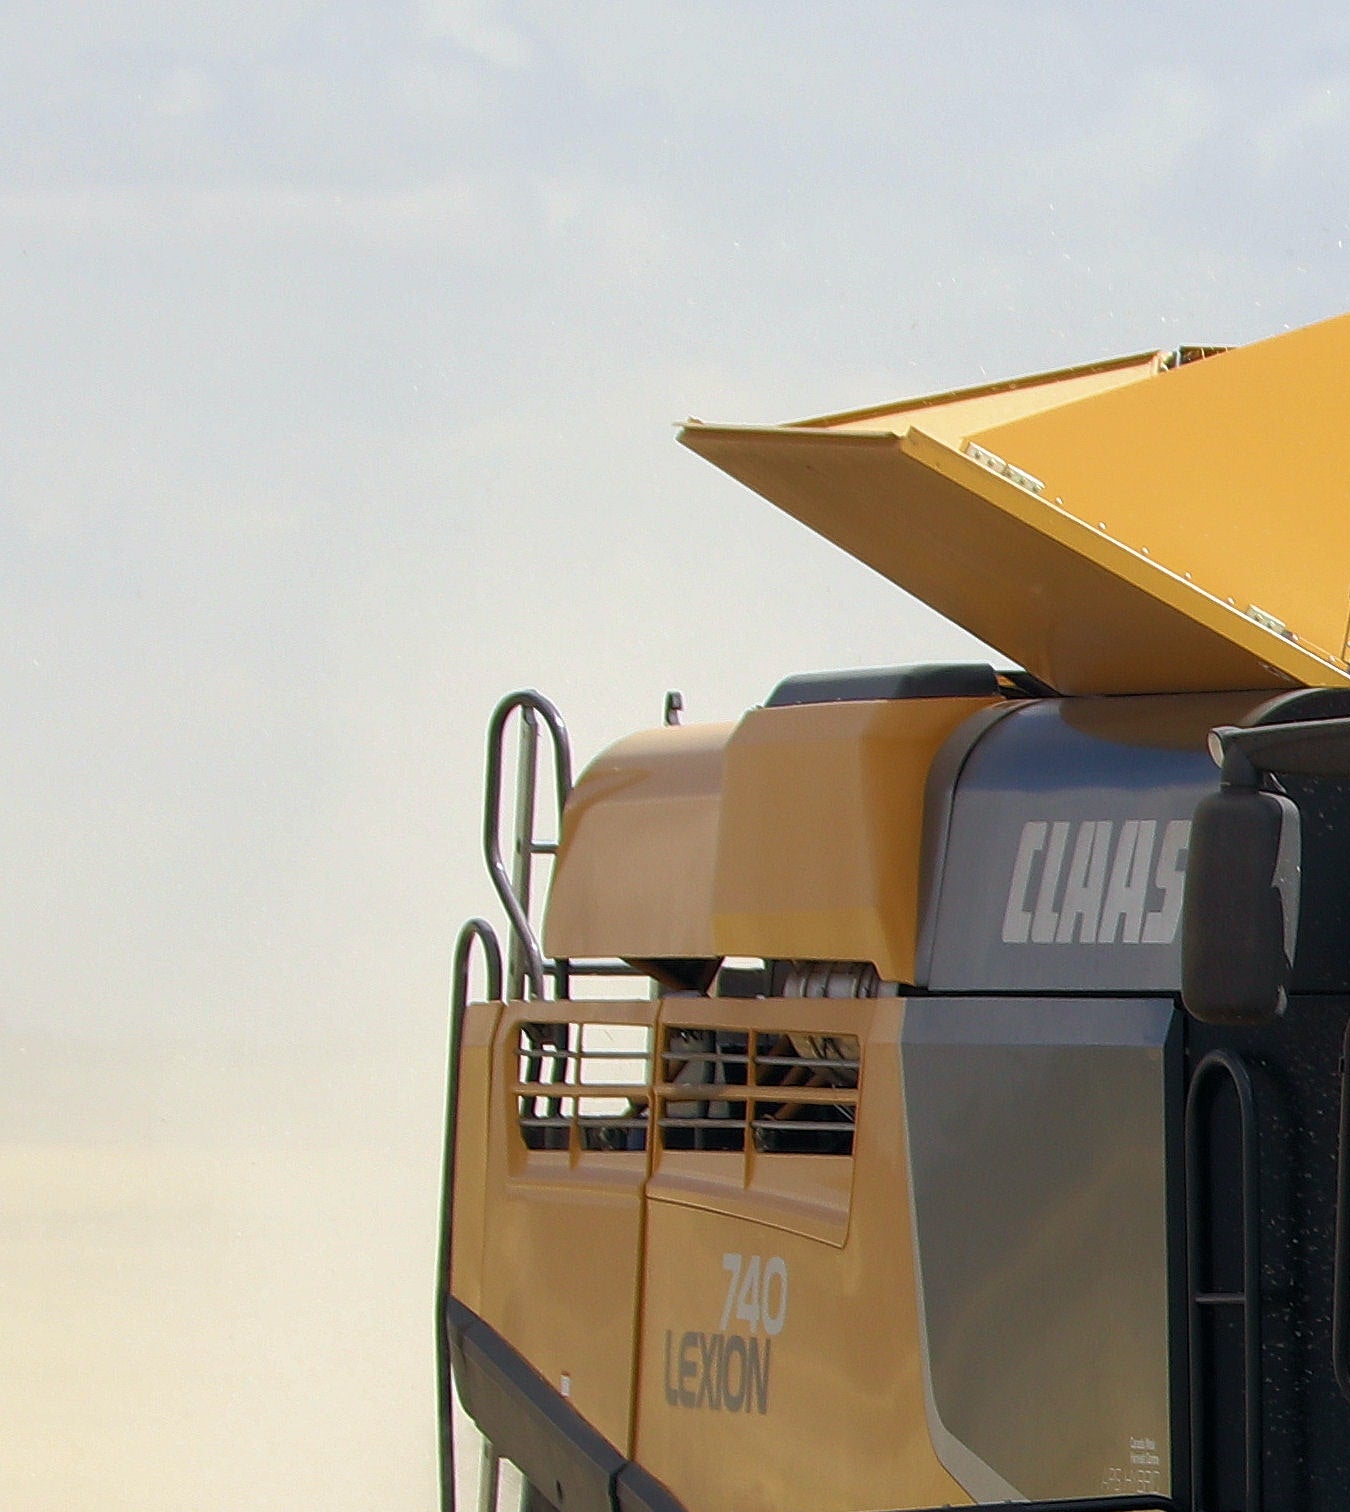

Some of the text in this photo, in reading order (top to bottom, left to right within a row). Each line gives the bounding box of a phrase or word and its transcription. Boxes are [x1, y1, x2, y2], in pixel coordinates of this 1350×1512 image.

[1001, 819, 1193, 944] CLAAS
[719, 1252, 788, 1336] 740
[664, 1329, 771, 1414] LEXION
